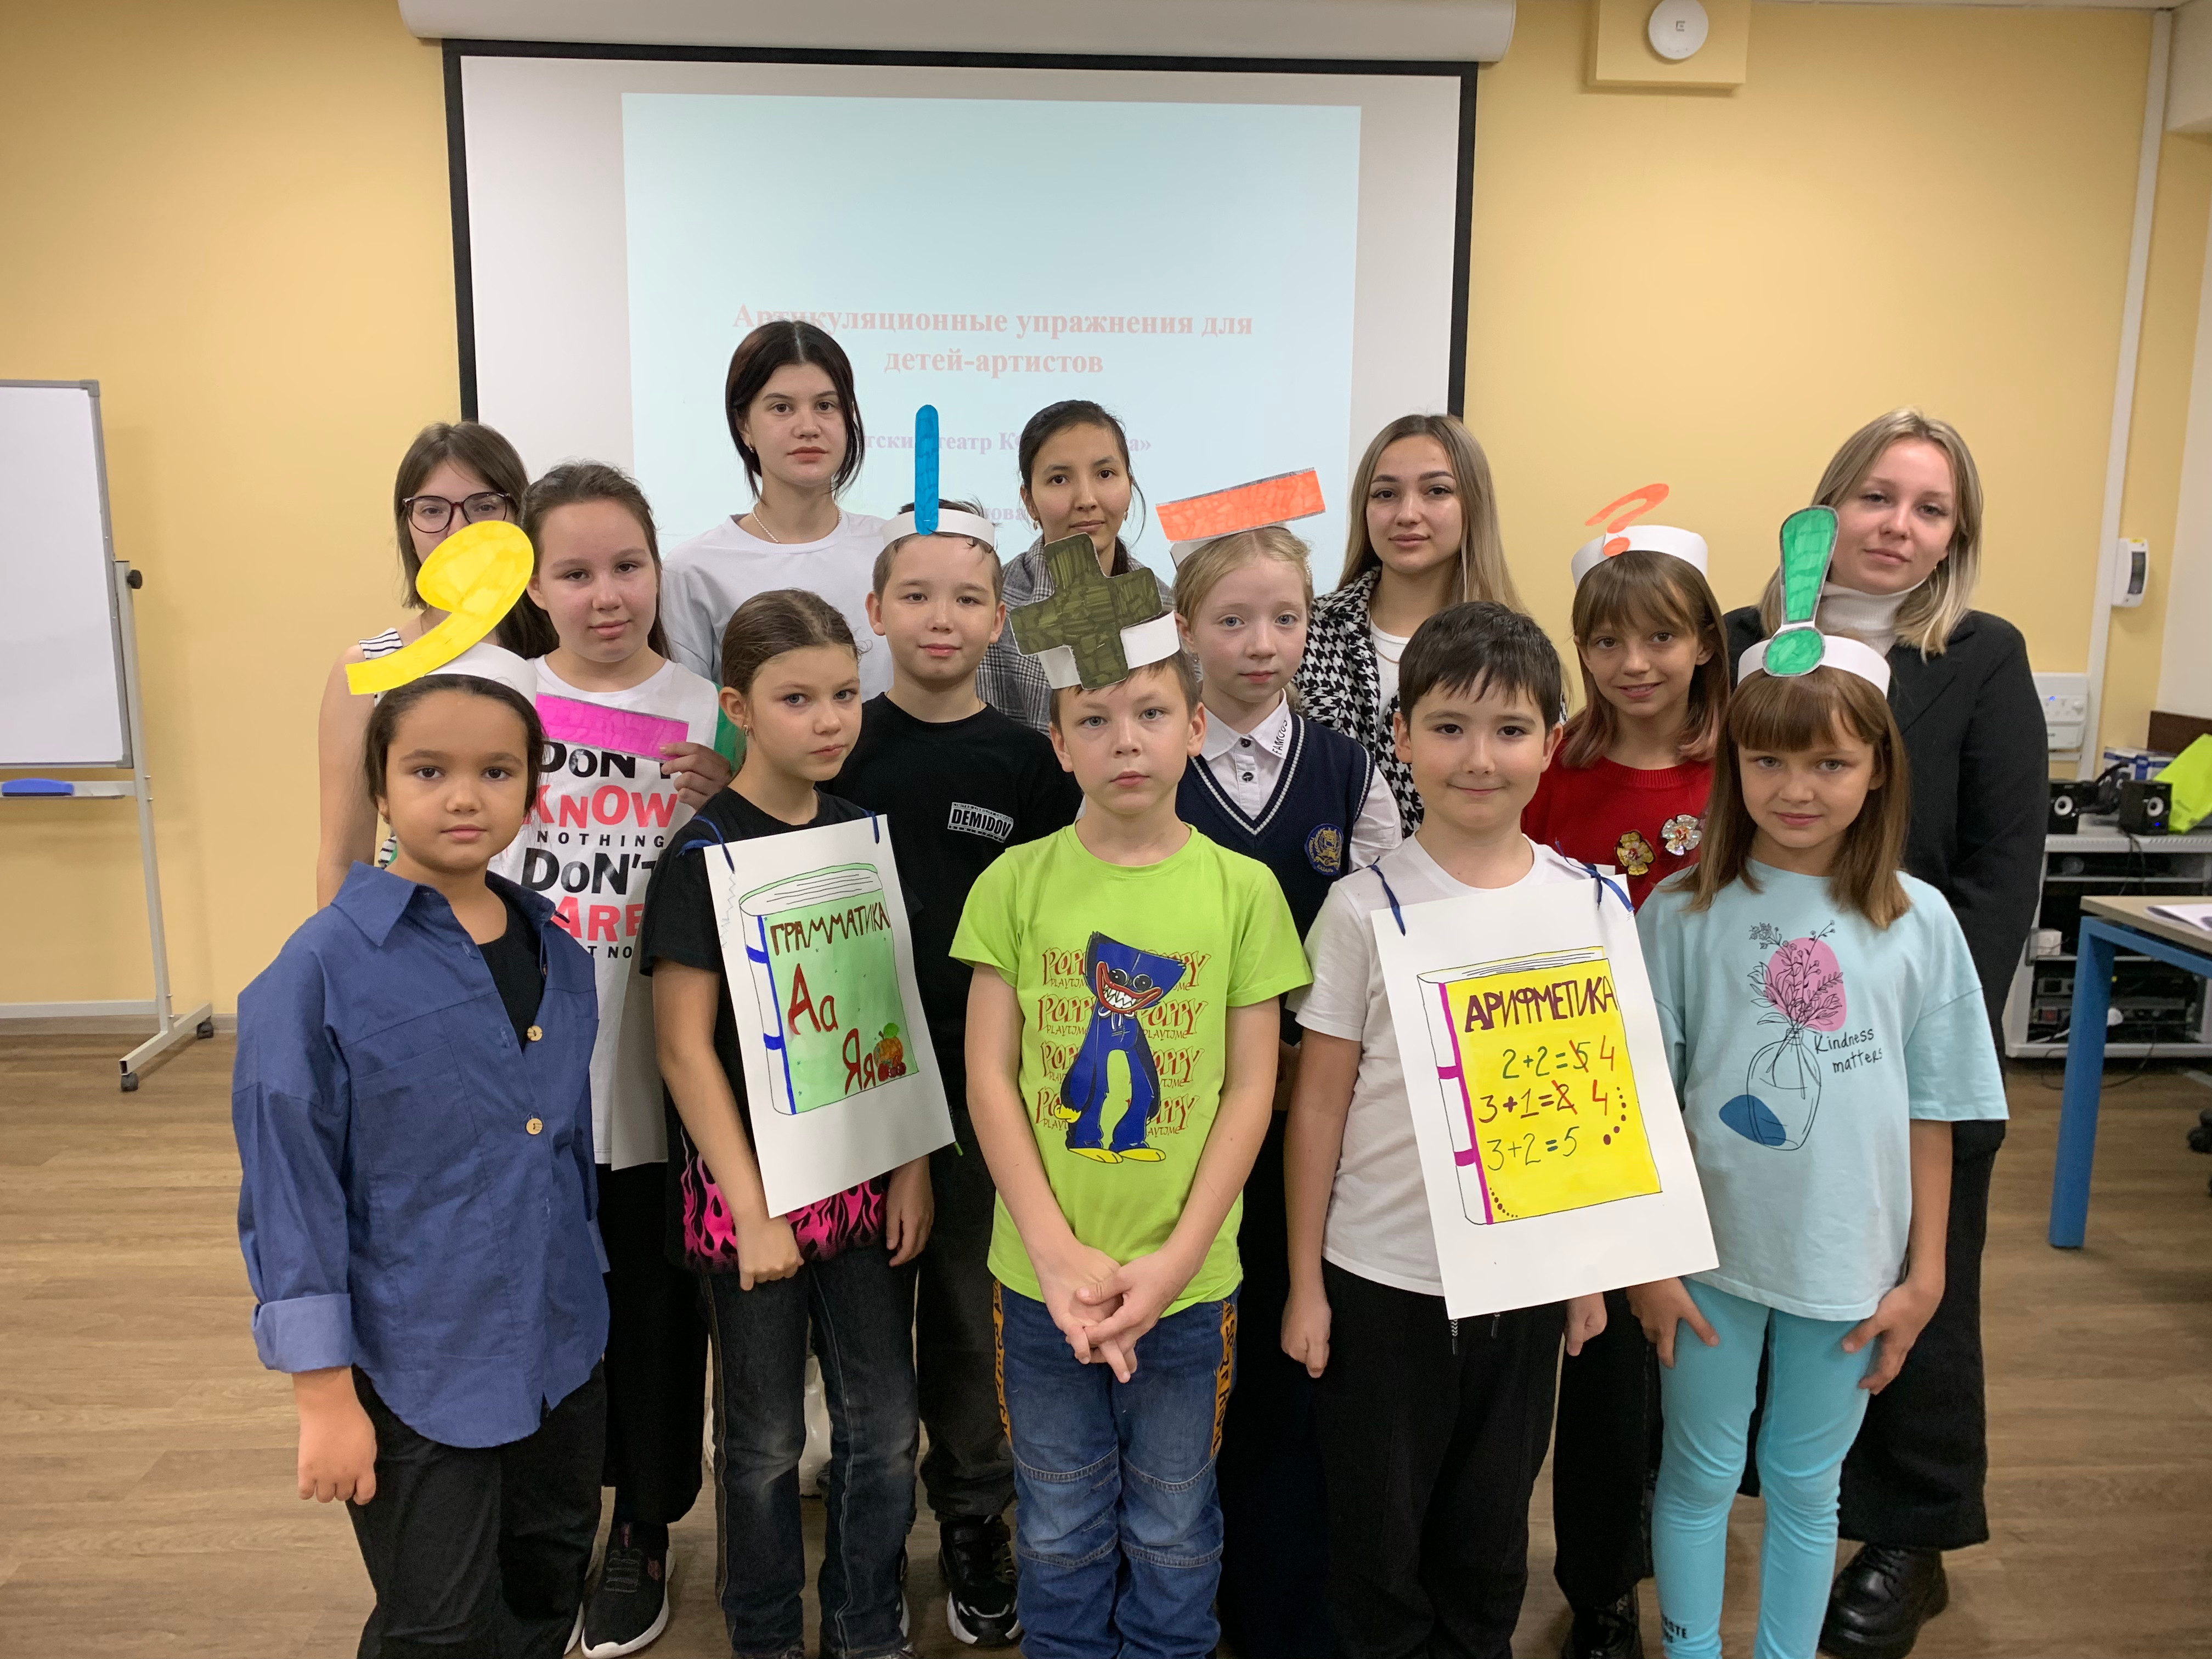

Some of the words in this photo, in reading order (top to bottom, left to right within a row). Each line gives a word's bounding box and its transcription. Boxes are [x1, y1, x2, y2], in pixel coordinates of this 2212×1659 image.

[1016, 314, 1193, 340] упражнения
[1201, 316, 1253, 338] для
[884, 347, 1104, 379] детей-артистов
[537, 830, 665, 848] NOTHING
[952, 809, 1011, 837] DEMIDOV
[551, 895, 644, 942] ARE
[770, 901, 891, 956] ГРАММАТИКА
[788, 962, 838, 1035] Аа
[1037, 993, 1097, 1032] POPP
[1464, 975, 1618, 1033] АРИФМЕТИКА
[1814, 1028, 1875, 1054] Kindness
[842, 1028, 876, 1096] Яя
[1150, 1045, 1205, 1083] OPPY
[1832, 1047, 1883, 1074] matters
